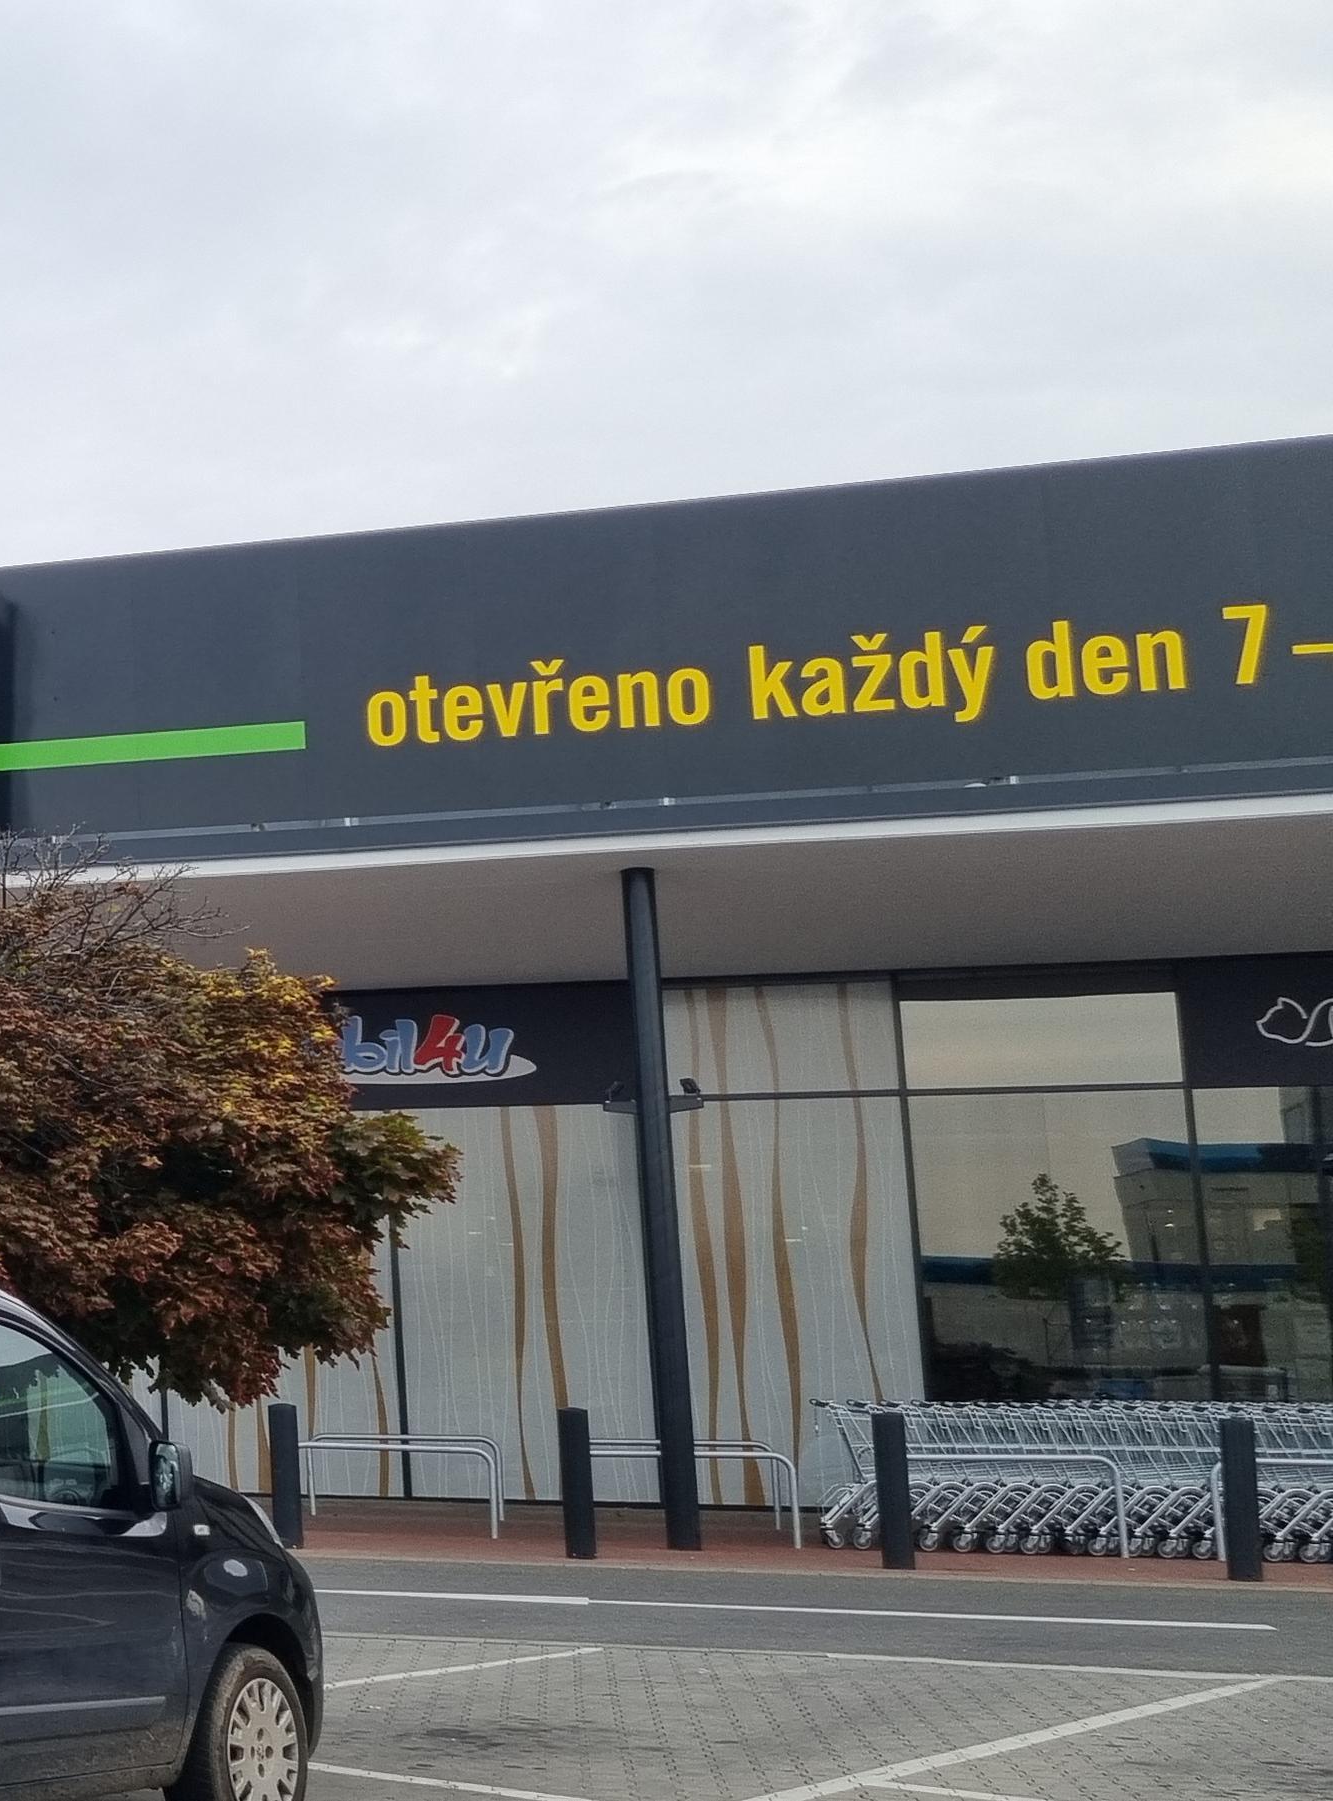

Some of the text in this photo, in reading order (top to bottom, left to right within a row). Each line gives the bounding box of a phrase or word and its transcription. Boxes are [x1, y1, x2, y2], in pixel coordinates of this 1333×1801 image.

[365, 658, 712, 748] otevřeno
[747, 624, 997, 724] každý
[1026, 619, 1189, 701] den
[1221, 603, 1271, 686] 7
